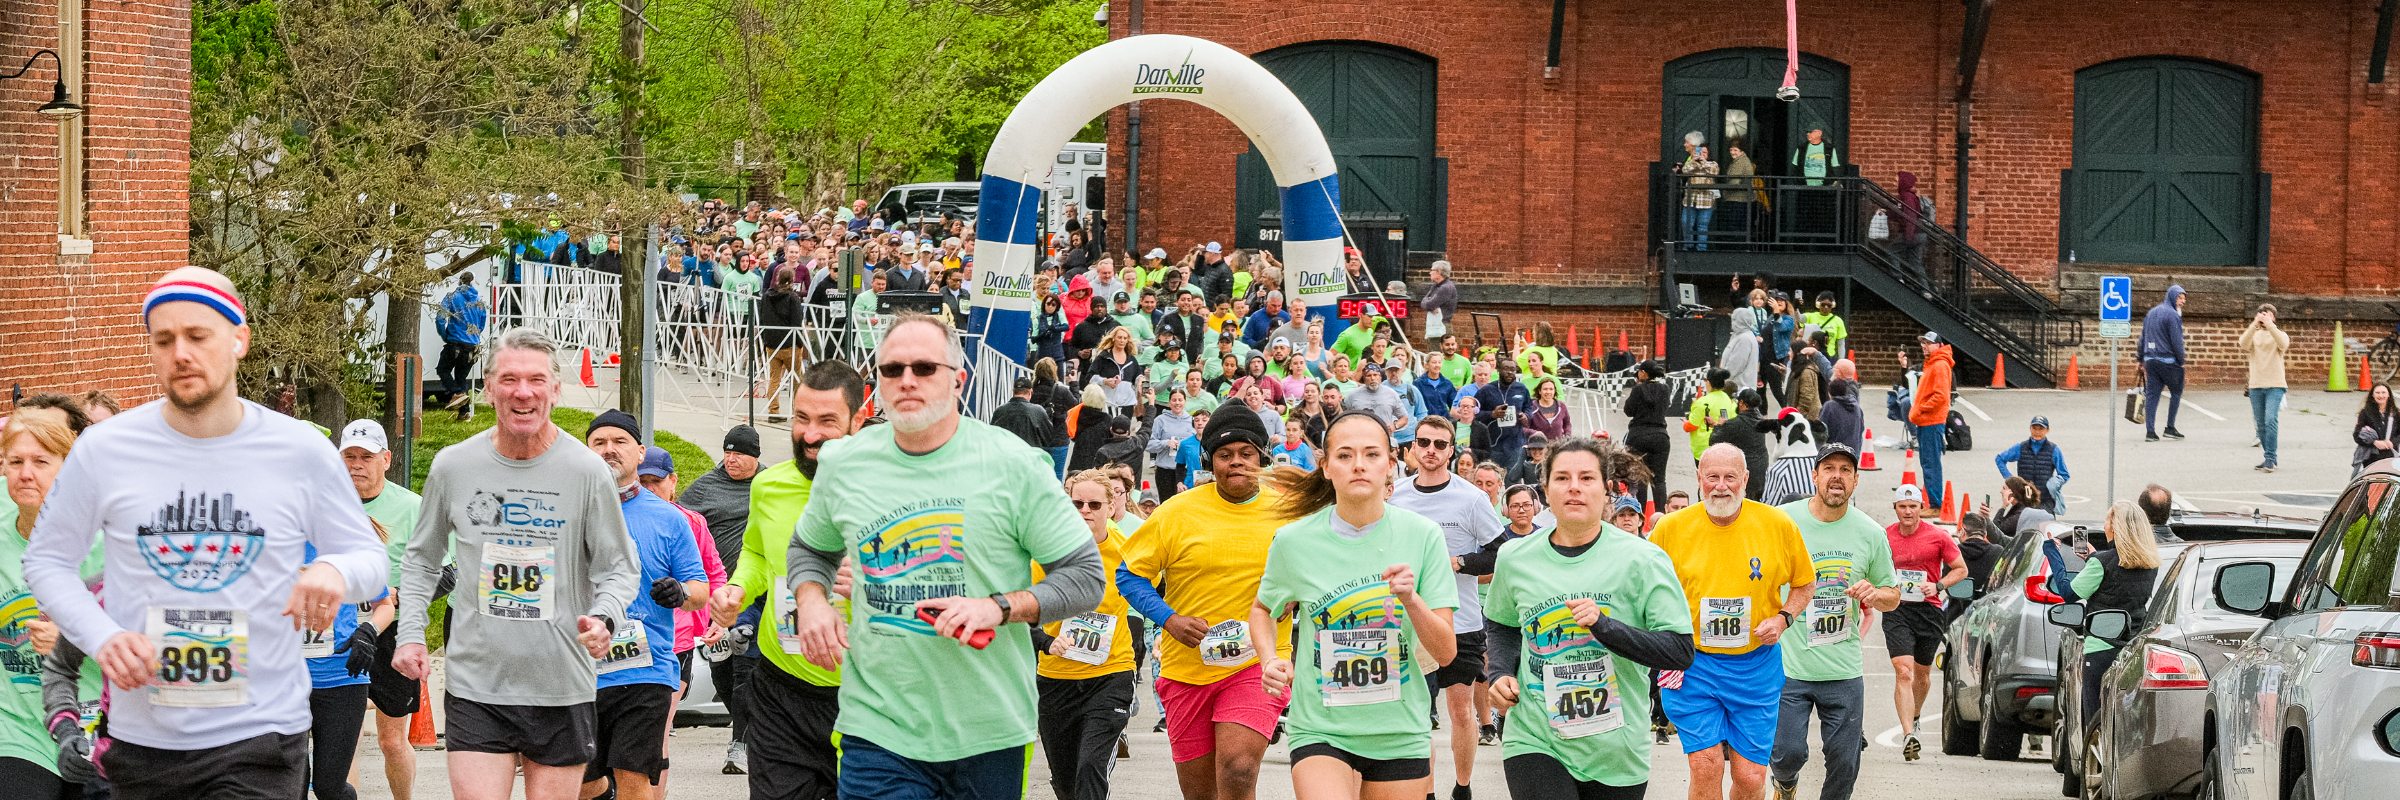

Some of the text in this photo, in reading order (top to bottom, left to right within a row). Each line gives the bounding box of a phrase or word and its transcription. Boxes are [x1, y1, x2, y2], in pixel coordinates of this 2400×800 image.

[1135, 61, 1205, 85] Danville
[984, 270, 1032, 290] Danville
[1299, 266, 1345, 287] Danville
[984, 288, 1031, 298] VIRGINIA
[1300, 284, 1345, 294] VIRGINIA
[521, 497, 555, 511] The
[501, 502, 566, 528] Bear
[856, 497, 966, 540] CELEBRATING 16 YEARS!
[497, 538, 533, 546] 2012
[888, 585, 893, 601] 2
[896, 585, 926, 601] BRIDGE
[928, 583, 966, 599] DANVILLE
[1307, 579, 1359, 614] CELEBRATING
[1360, 576, 1371, 585] 16
[1523, 591, 1612, 620] CELEBRATING 16 YEARS!
[1711, 617, 1741, 636] 118
[1816, 615, 1846, 634] 407
[1070, 627, 1101, 652] 170
[1352, 631, 1367, 641] BRIDGE
[1368, 629, 1387, 640] DANVILLE
[1217, 641, 1241, 658] 18
[162, 646, 233, 683] 393
[1333, 656, 1388, 687] 469
[1559, 687, 1611, 720] 452
